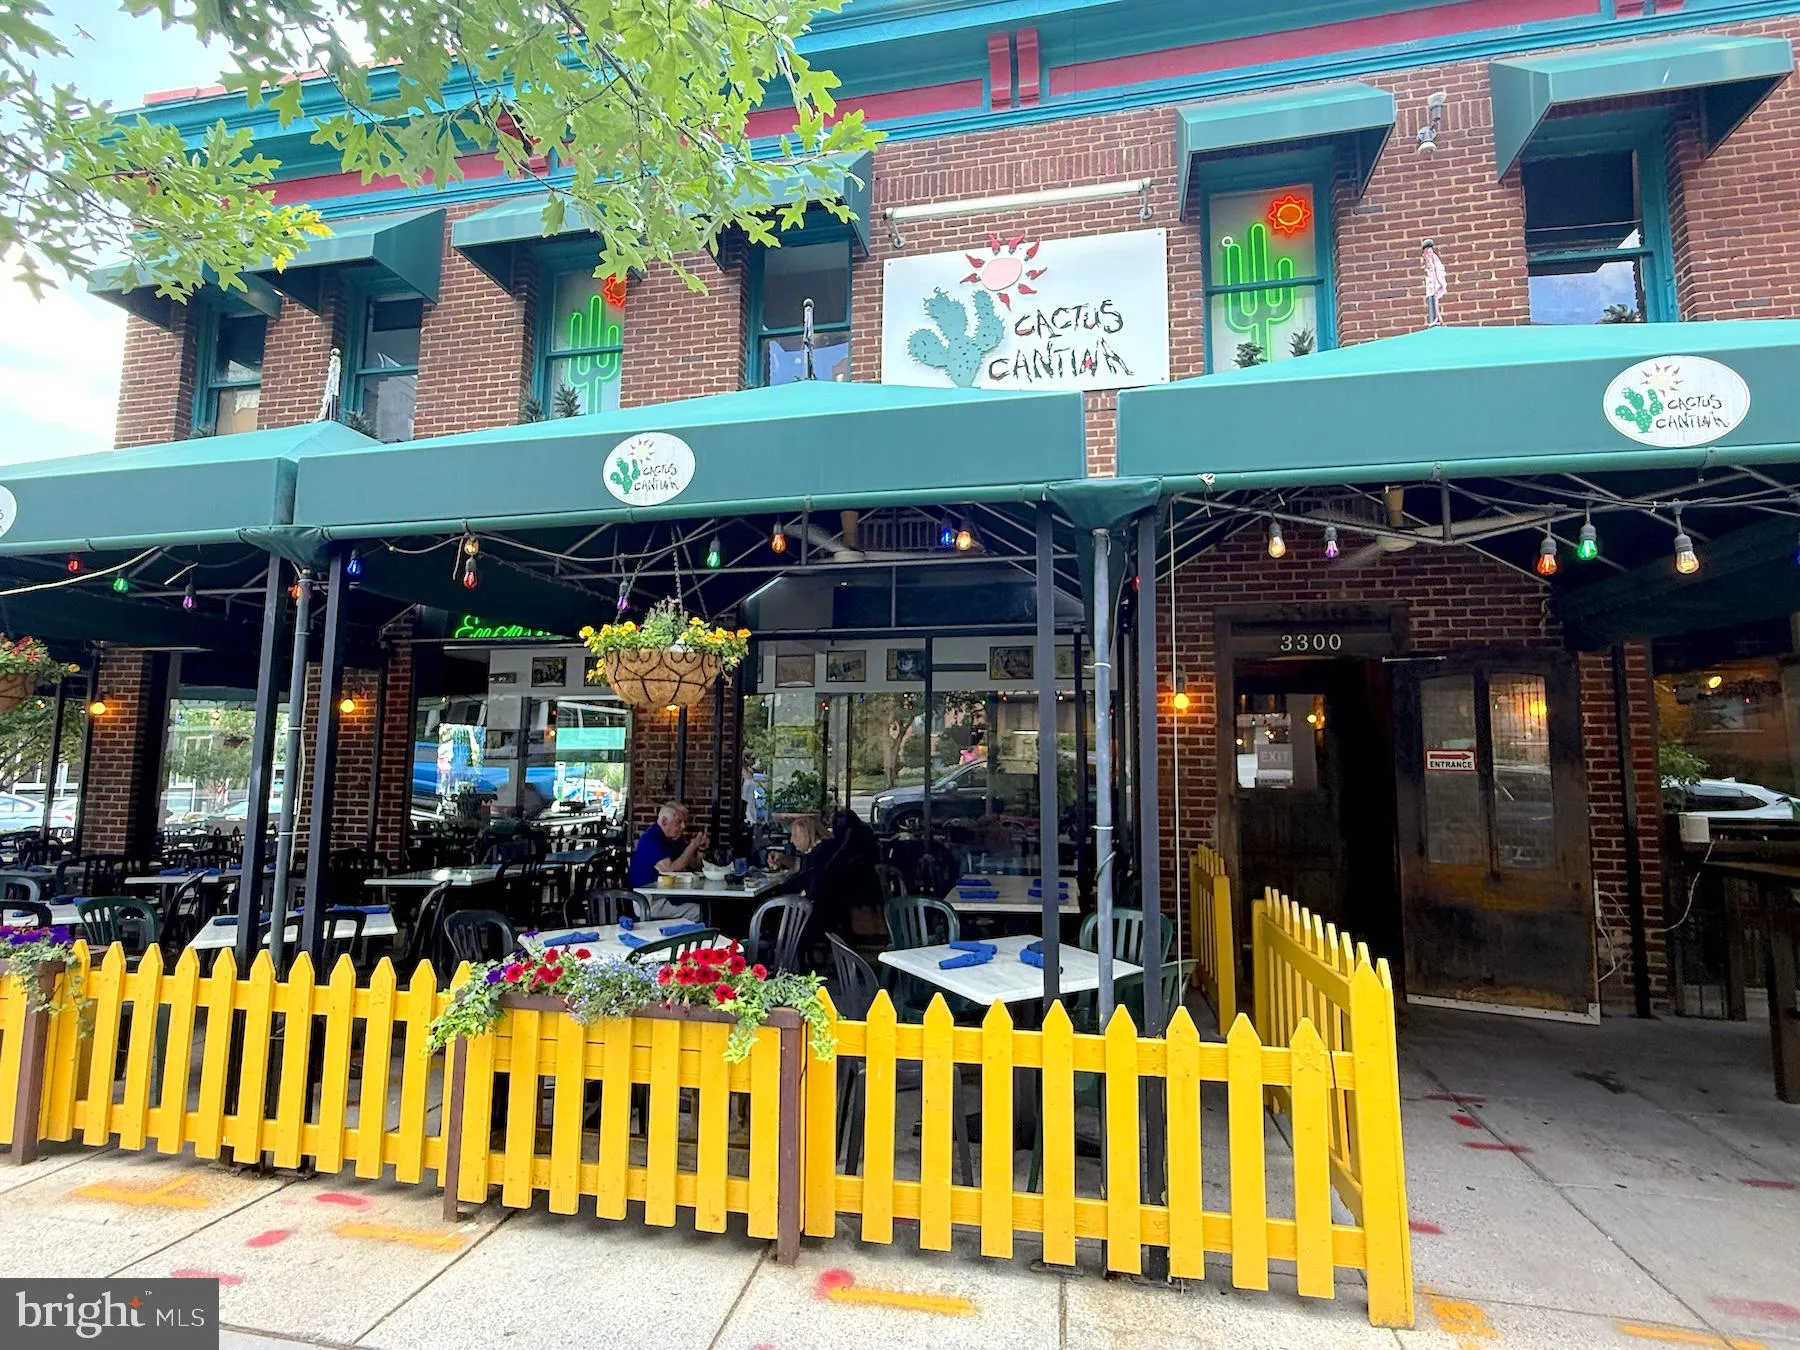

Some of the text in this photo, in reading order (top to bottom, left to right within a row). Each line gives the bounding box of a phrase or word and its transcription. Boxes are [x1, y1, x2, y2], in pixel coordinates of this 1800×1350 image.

[1014, 299, 1124, 338] CACTUS
[988, 337, 1135, 383] CANTINA
[1667, 394, 1722, 411] CACTUS
[1655, 410, 1729, 430] CANTINA
[643, 463, 678, 477] CACTUS
[1280, 633, 1342, 651] 3300
[1261, 750, 1289, 763] EXIT
[1430, 760, 1473, 769] ENTRANCE
